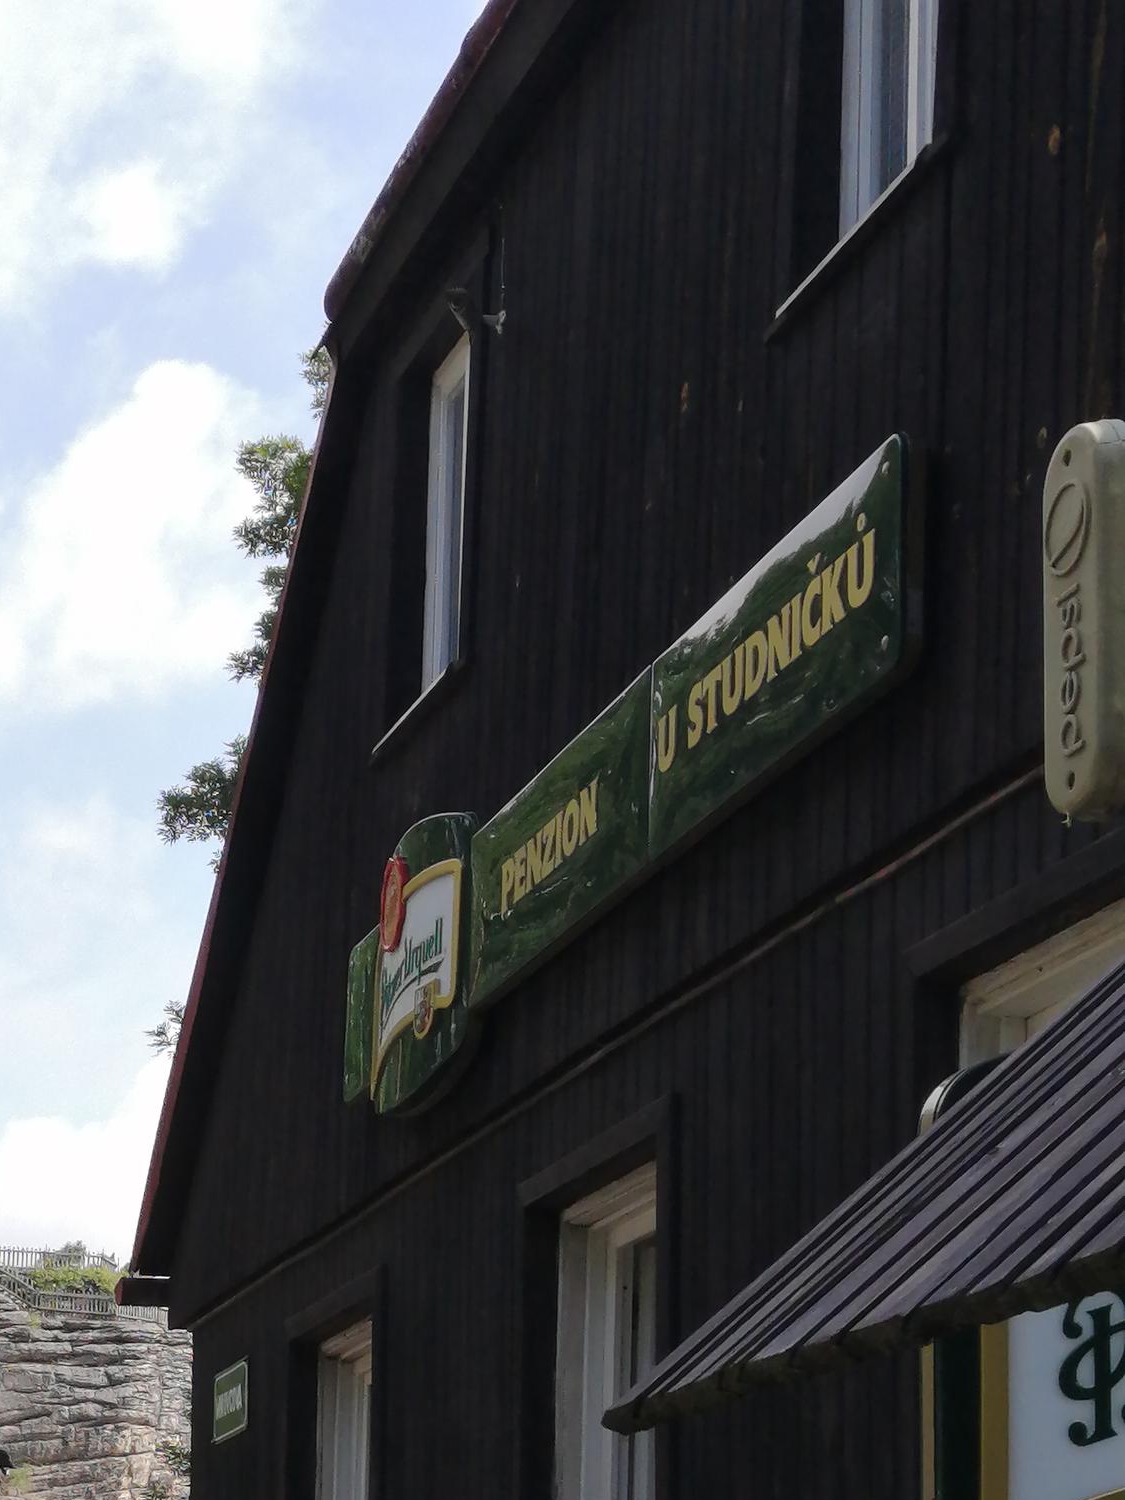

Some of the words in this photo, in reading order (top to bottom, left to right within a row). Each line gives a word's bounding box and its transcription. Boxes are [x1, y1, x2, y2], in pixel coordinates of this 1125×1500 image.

[500, 776, 599, 913] PENZION
[657, 704, 677, 773] U
[687, 512, 876, 750] STUDNIČKŮ
[403, 916, 444, 987] Urquell
